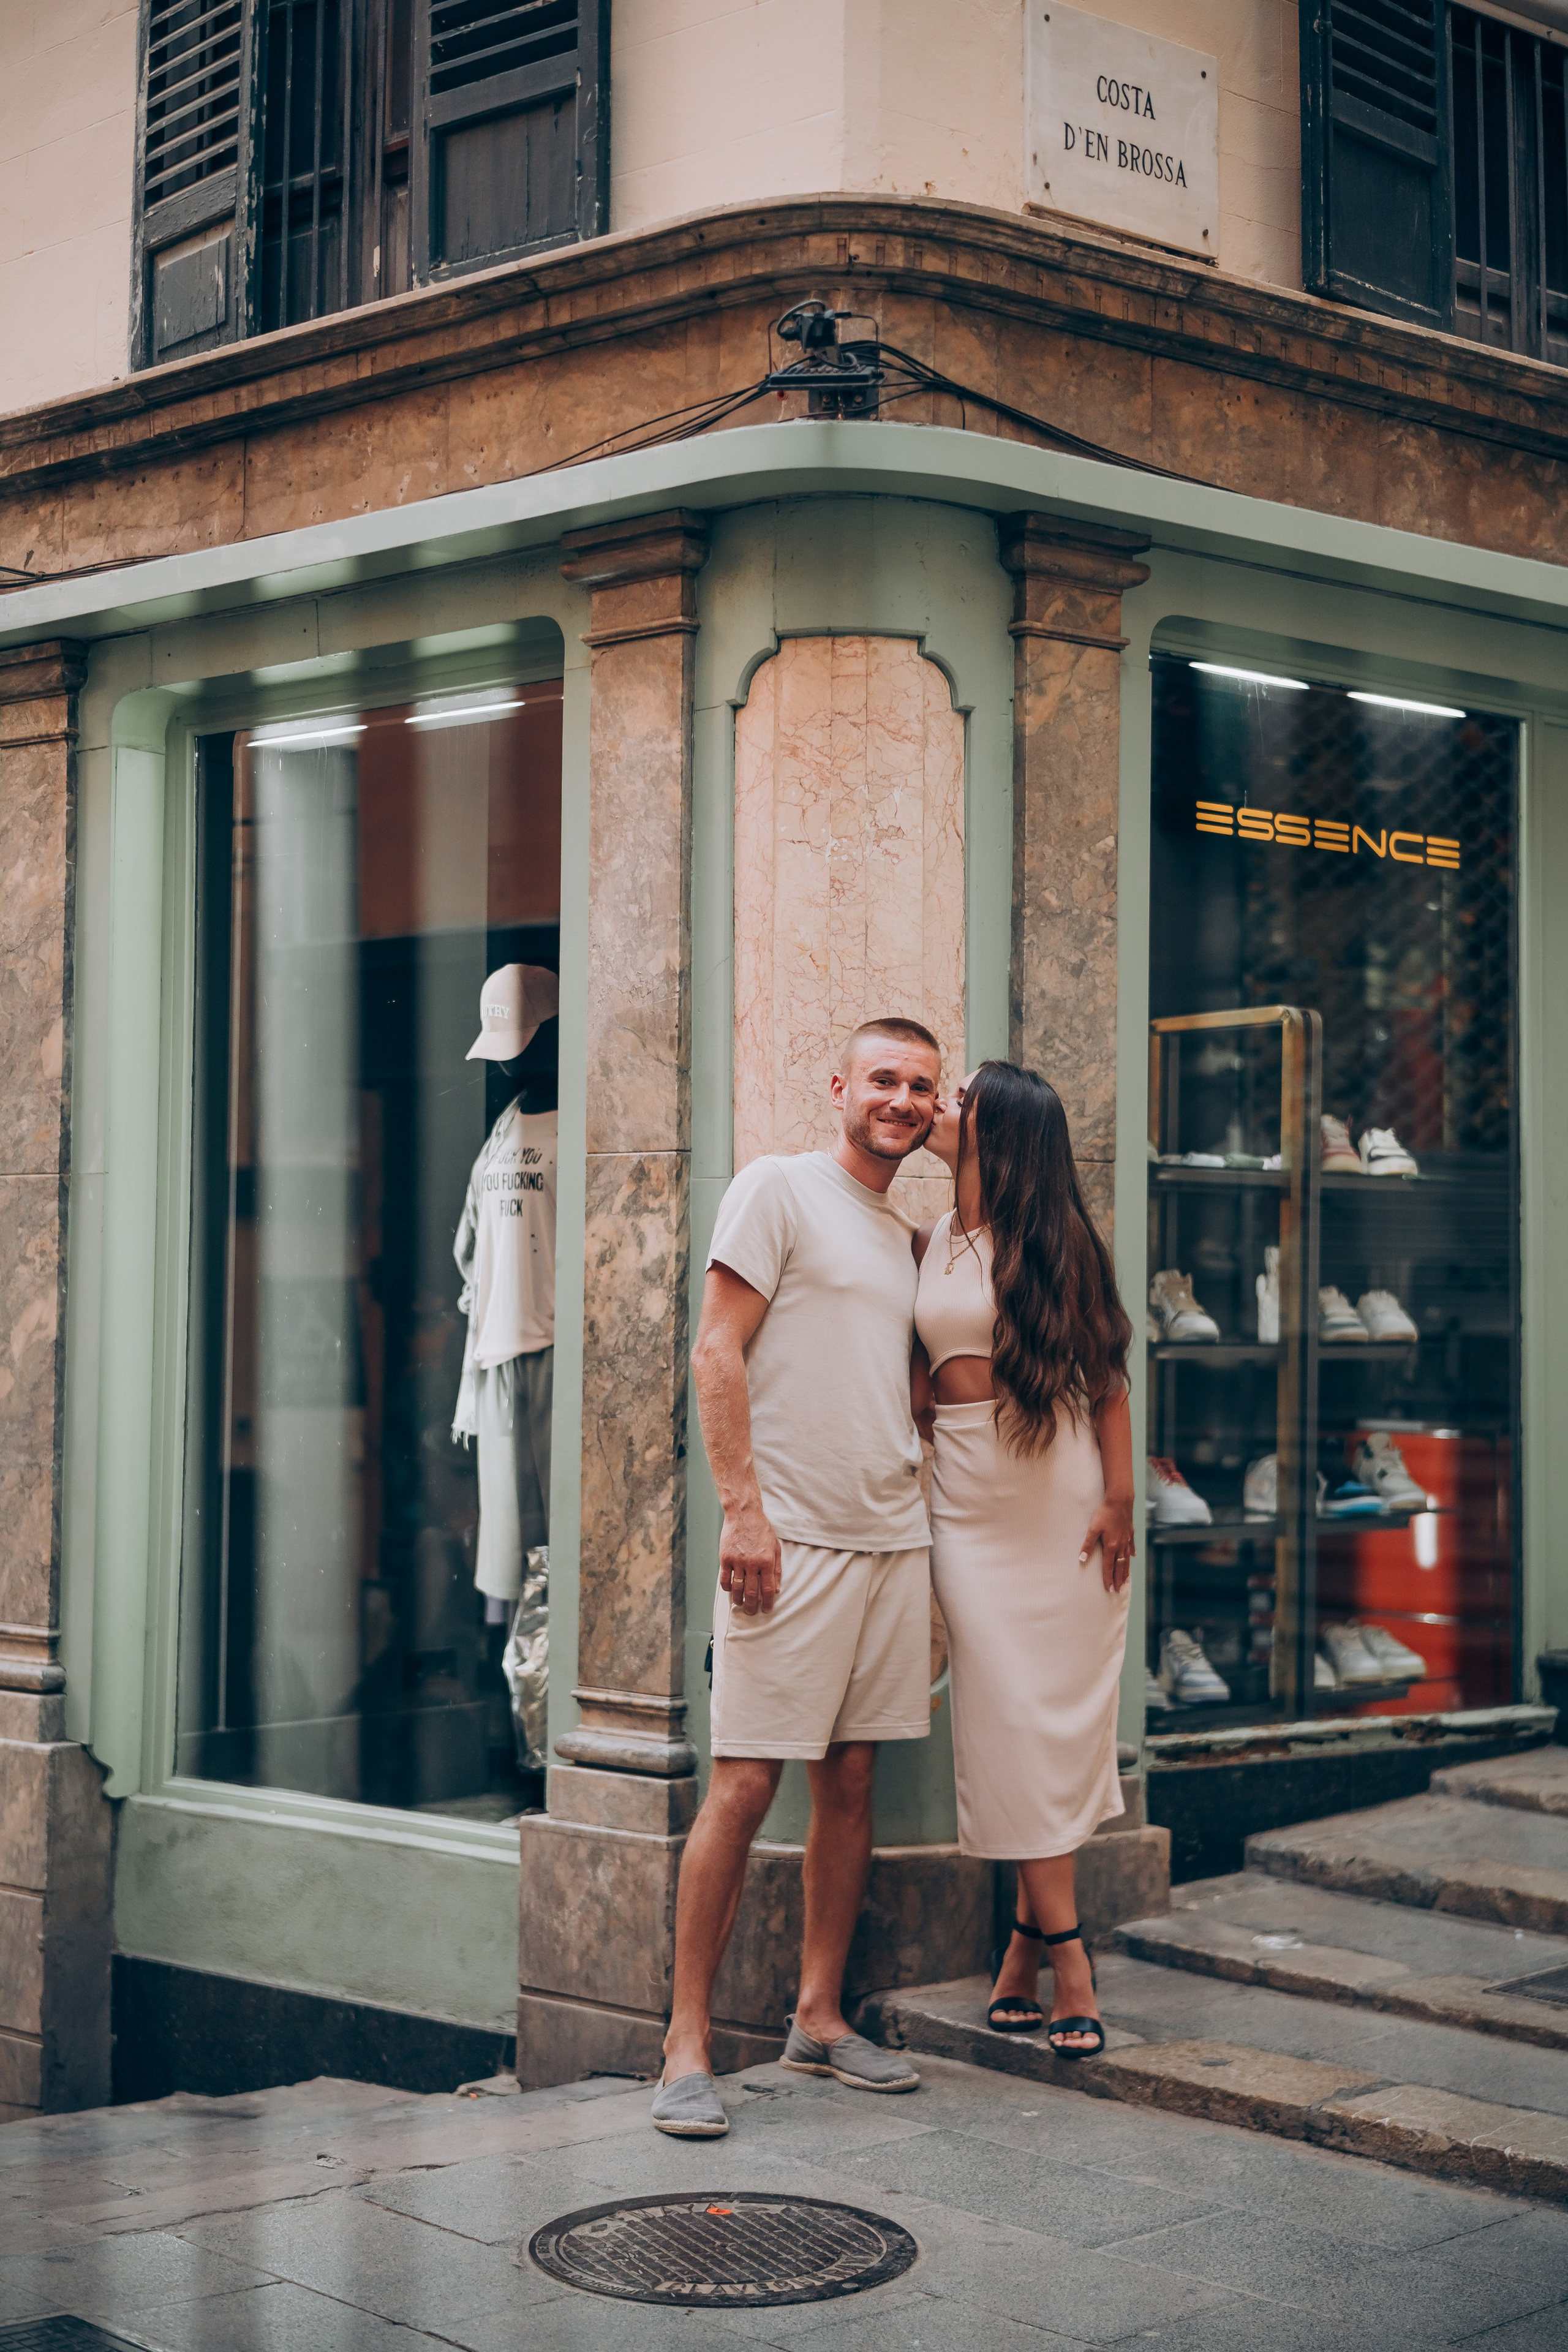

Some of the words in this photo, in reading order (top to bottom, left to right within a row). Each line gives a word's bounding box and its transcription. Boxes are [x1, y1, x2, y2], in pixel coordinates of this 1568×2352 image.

[1096, 75, 1156, 121] COSTA
[1063, 122, 1109, 163] D'EN
[1117, 139, 1188, 189] BROSSA
[1196, 801, 1461, 870] ESSENCE
[483, 1004, 510, 1020] UTRY
[521, 1147, 543, 1165] YOU
[482, 1172, 499, 1192] YOU
[502, 1171, 544, 1192] FUCKING
[500, 1198, 524, 1218] FUCK
